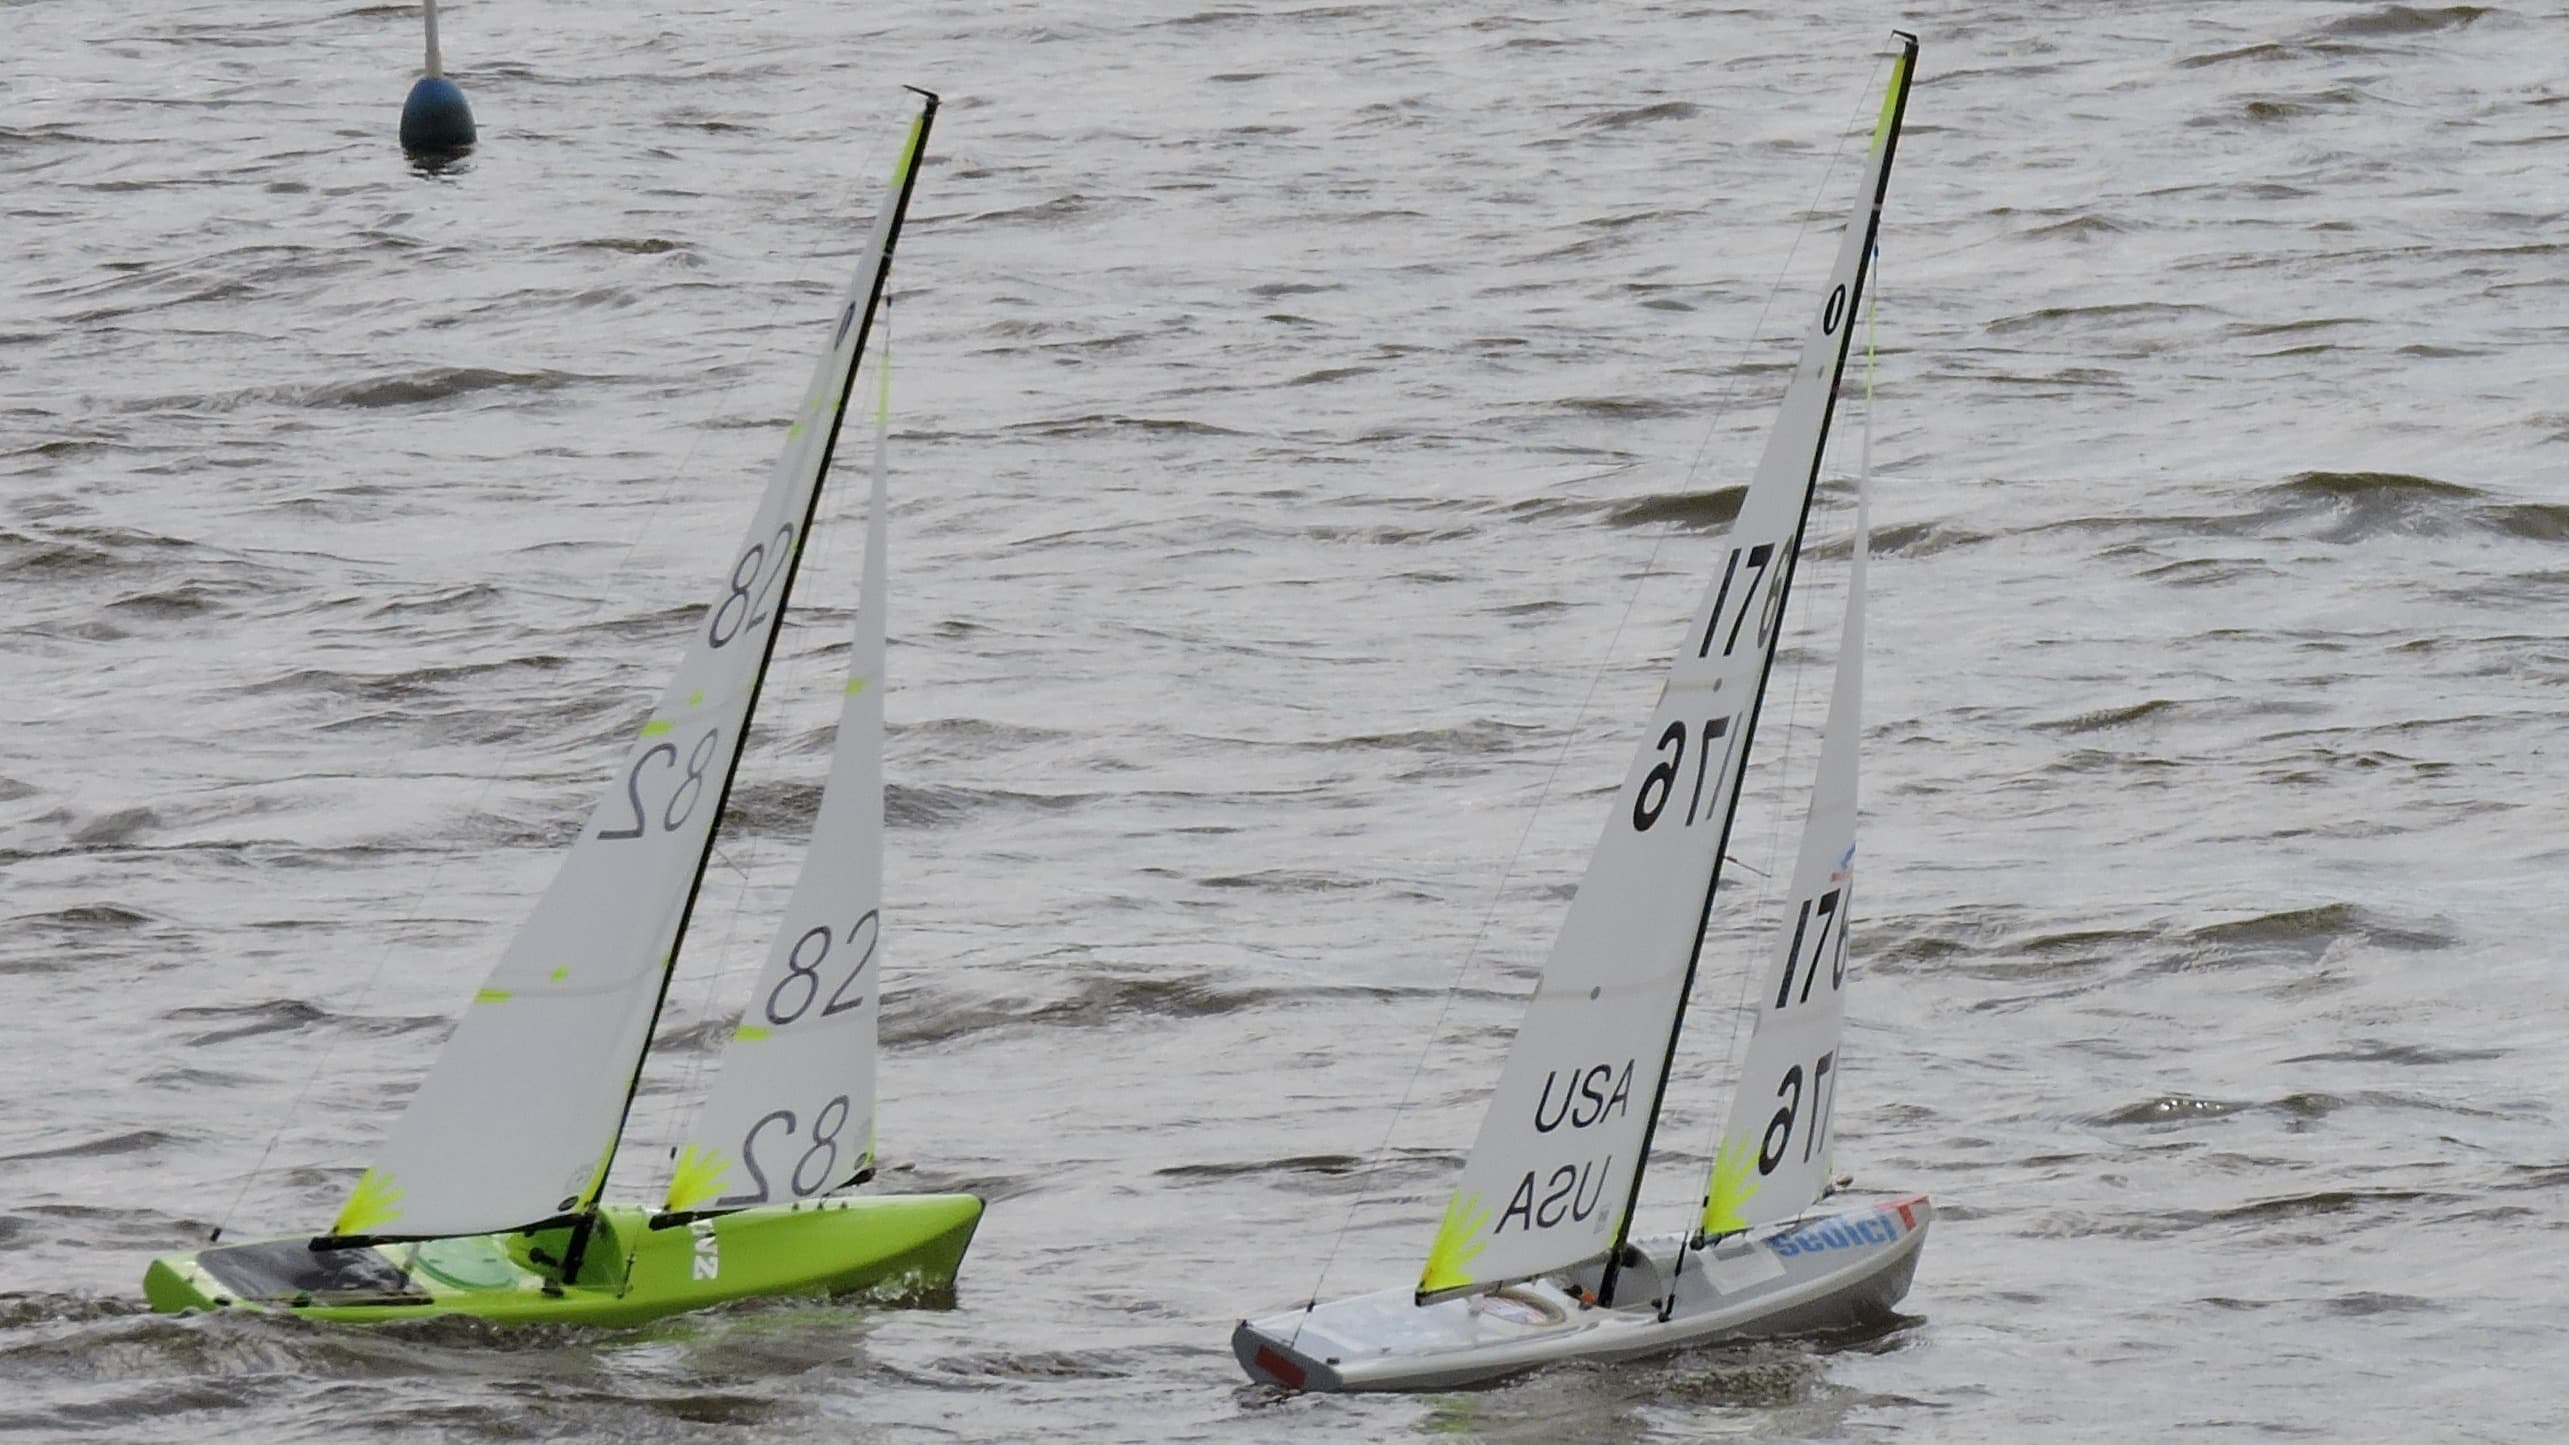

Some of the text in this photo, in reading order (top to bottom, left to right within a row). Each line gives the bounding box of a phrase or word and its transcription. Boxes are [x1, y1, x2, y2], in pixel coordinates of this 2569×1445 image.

[709, 522, 794, 648] 82
[766, 909, 879, 1025] 82
[1535, 1058, 1635, 1134] USA
